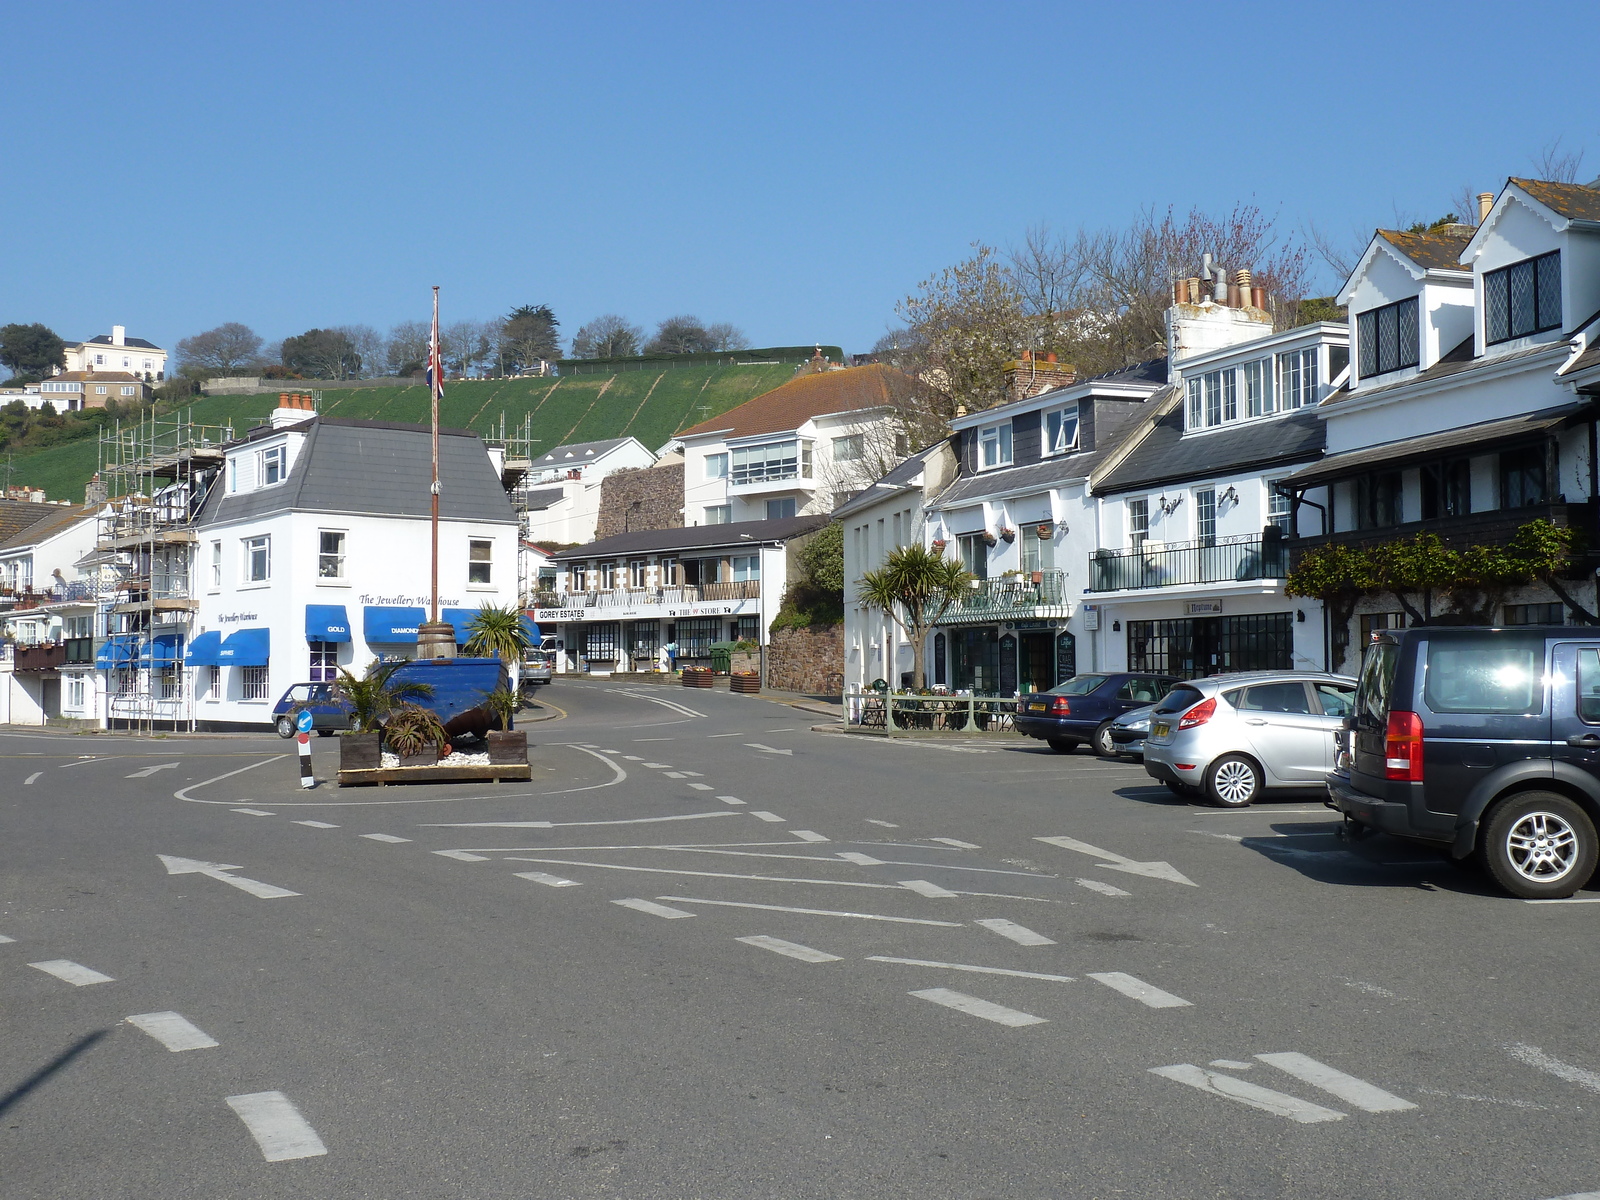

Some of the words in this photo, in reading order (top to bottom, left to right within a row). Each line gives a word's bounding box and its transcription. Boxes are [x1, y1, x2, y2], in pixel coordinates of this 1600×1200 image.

[359, 594, 375, 604] The
[375, 595, 415, 607] Jewellery
[416, 595, 460, 606] Wahouse
[539, 611, 559, 619] GOREY
[560, 610, 585, 618] ESTATES
